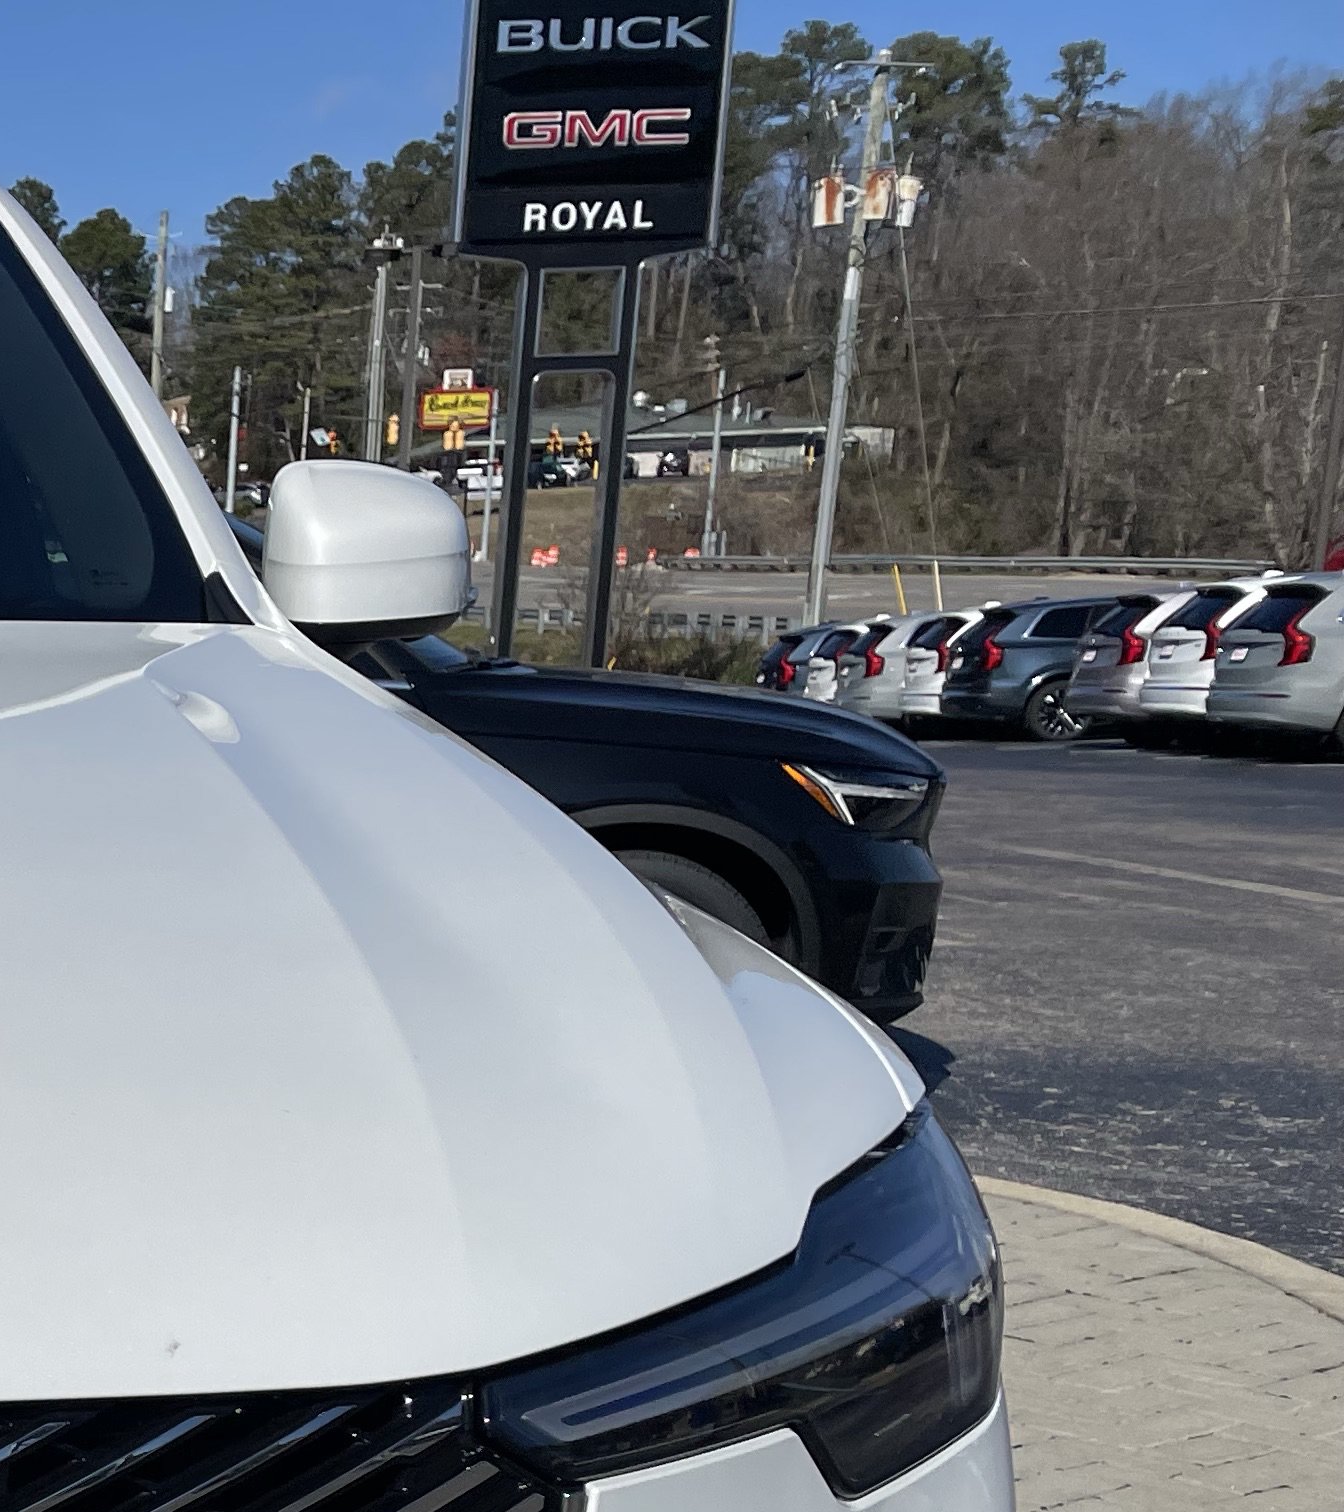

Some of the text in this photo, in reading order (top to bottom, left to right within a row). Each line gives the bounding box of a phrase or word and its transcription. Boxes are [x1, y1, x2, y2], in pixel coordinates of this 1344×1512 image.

[496, 15, 711, 52] BUICK
[502, 107, 691, 149] GMC
[523, 200, 654, 232] ROYAL
